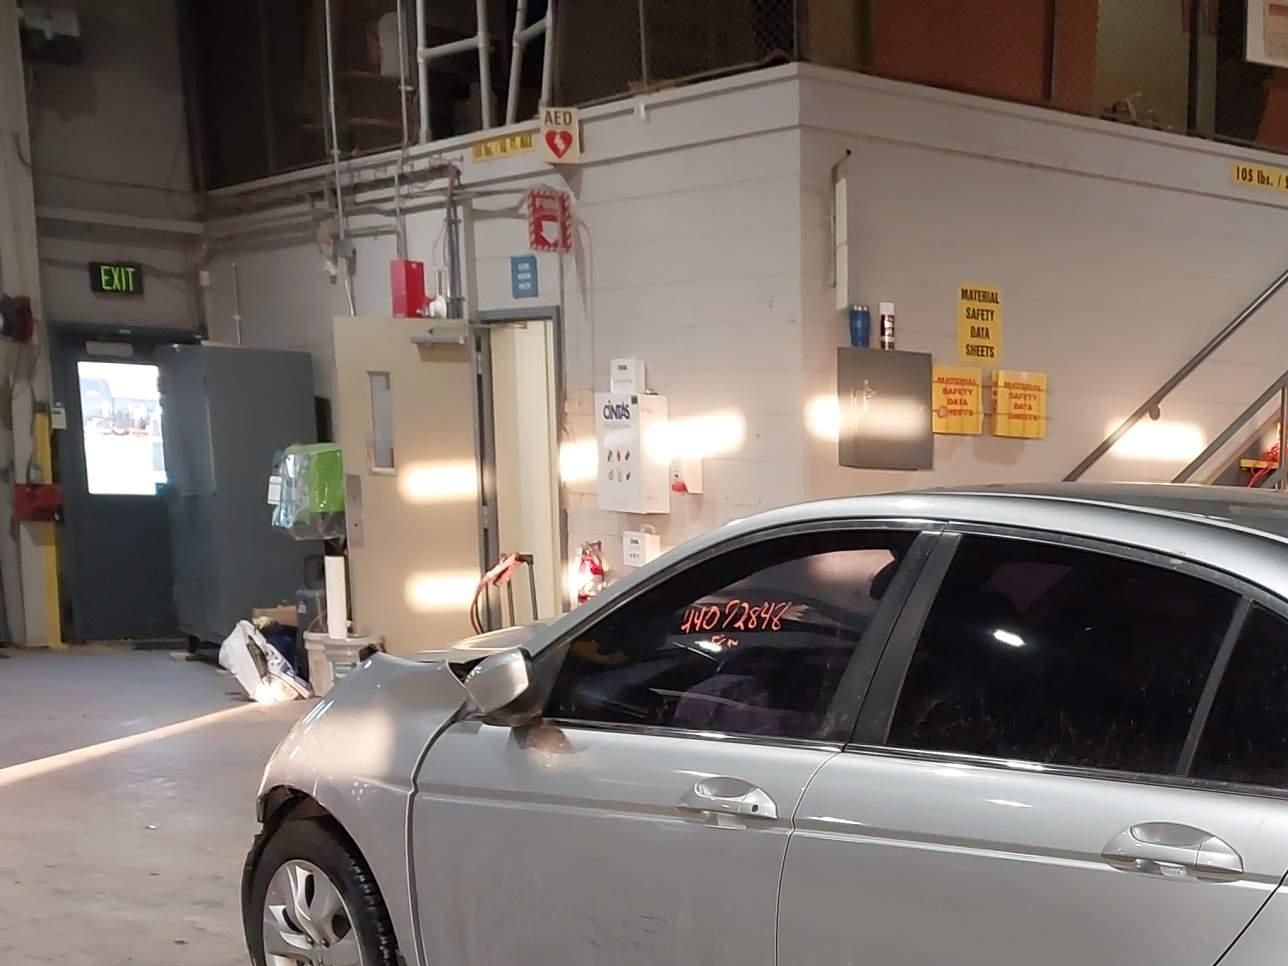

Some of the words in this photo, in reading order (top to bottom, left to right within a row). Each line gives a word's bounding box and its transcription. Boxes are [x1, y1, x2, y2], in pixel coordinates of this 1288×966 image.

[544, 110, 573, 126] AED
[1236, 166, 1254, 182] 105
[1257, 169, 1274, 187] lbs.
[1276, 173, 1283, 188] /
[100, 265, 136, 292] EXIT
[960, 287, 1000, 305] MATERIAL
[965, 306, 995, 323] SAFETY
[970, 325, 991, 341] DATA
[965, 343, 995, 359] SHEETS
[942, 387, 975, 397] SAFETY
[946, 398, 969, 407] DATA
